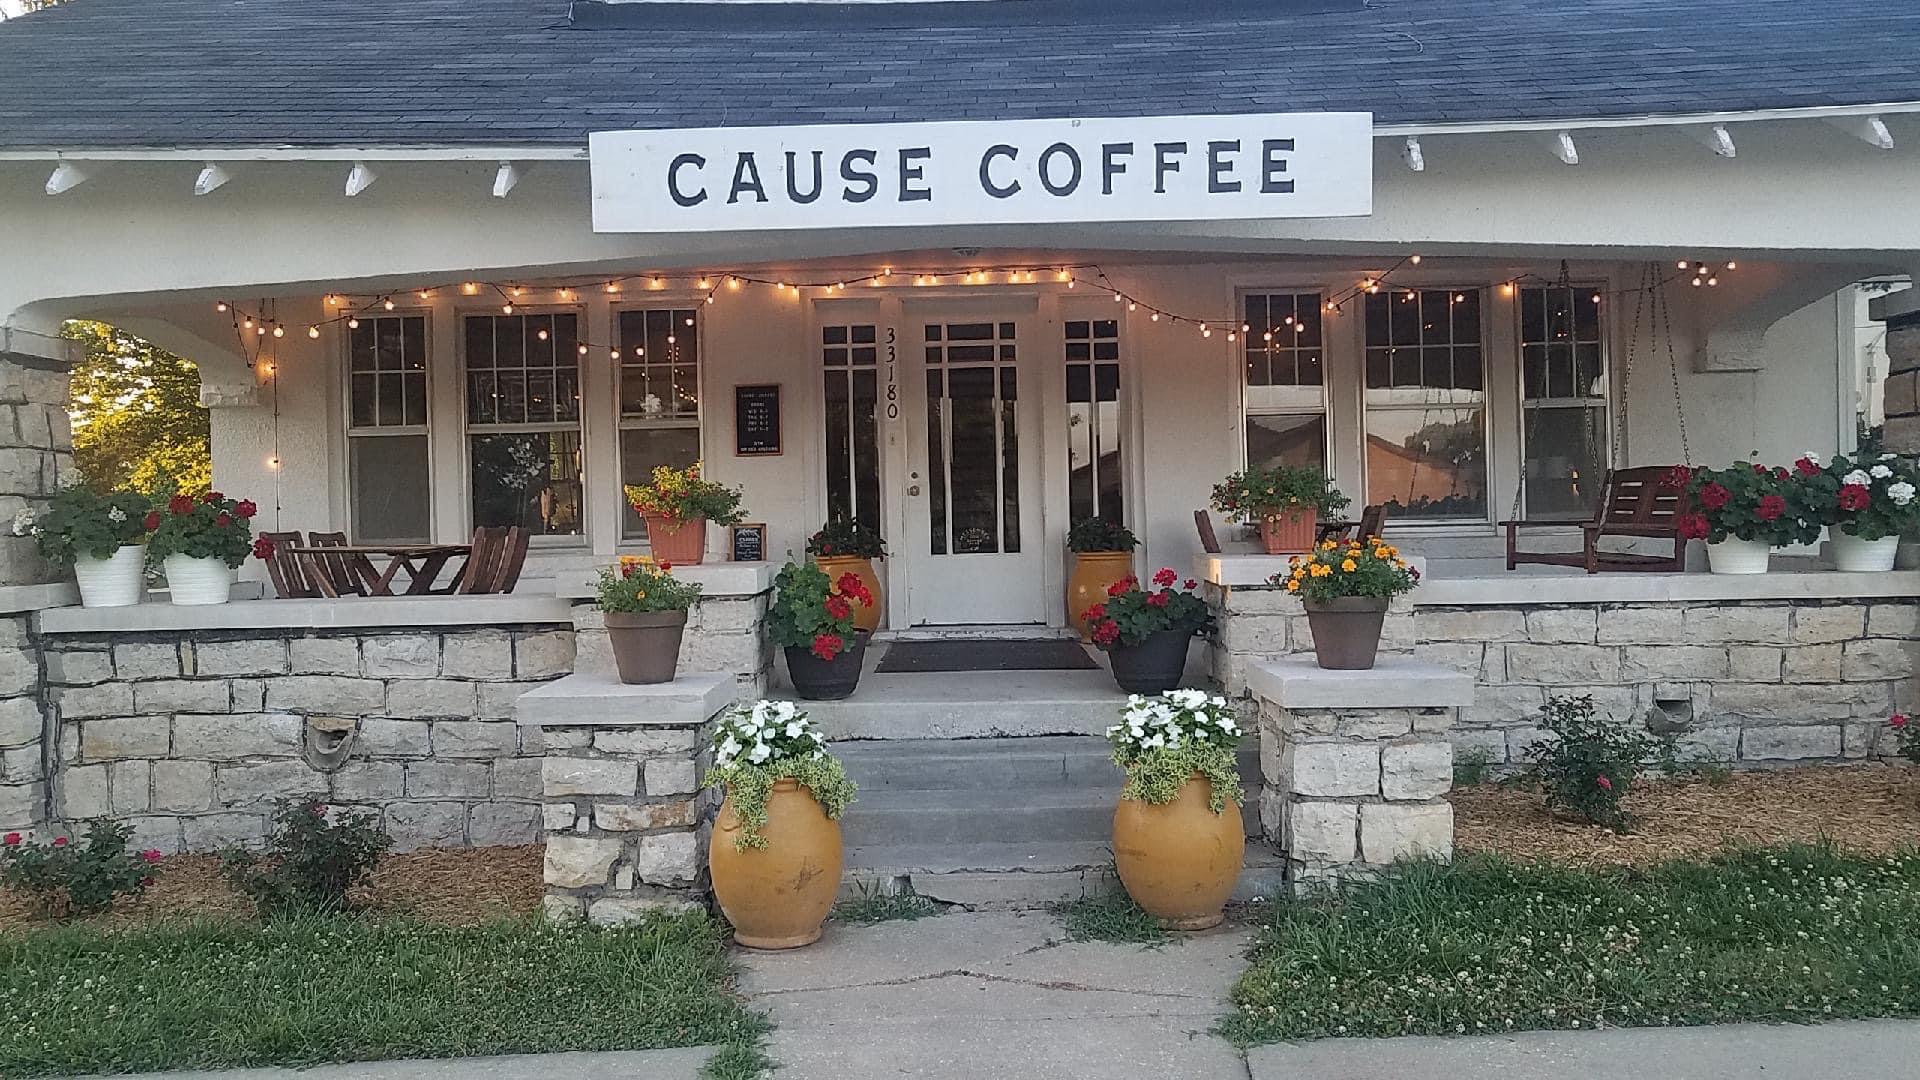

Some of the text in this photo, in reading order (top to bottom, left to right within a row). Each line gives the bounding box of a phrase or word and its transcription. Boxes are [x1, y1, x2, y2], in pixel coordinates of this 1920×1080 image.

[667, 138, 1295, 208] CAUSE COFFEE
[885, 327, 898, 419] 33180
